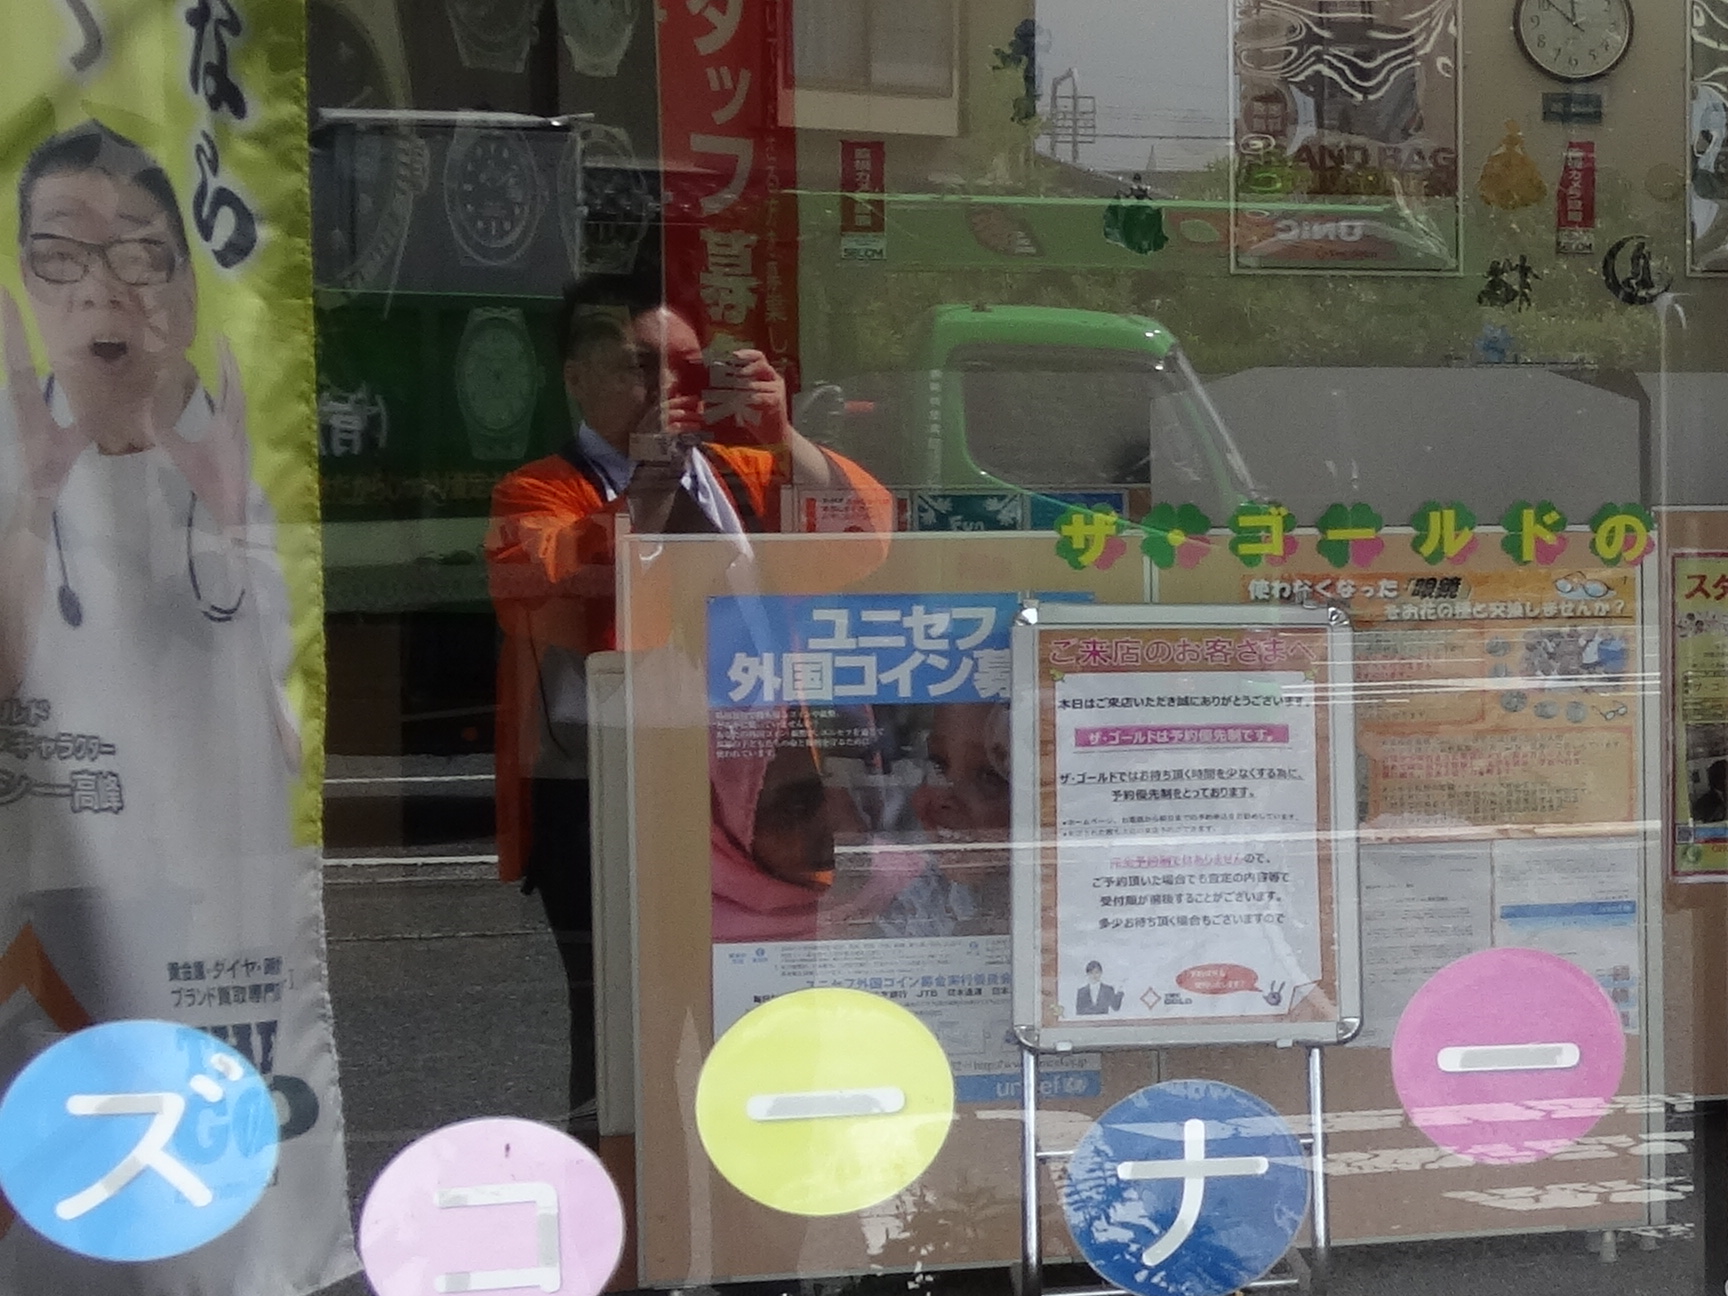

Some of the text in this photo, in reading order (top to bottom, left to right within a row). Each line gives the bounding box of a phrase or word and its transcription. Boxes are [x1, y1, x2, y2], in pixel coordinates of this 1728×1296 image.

[808, 604, 998, 651] ユニセフ
[1050, 637, 1318, 667] ご来店のお客さまへ
